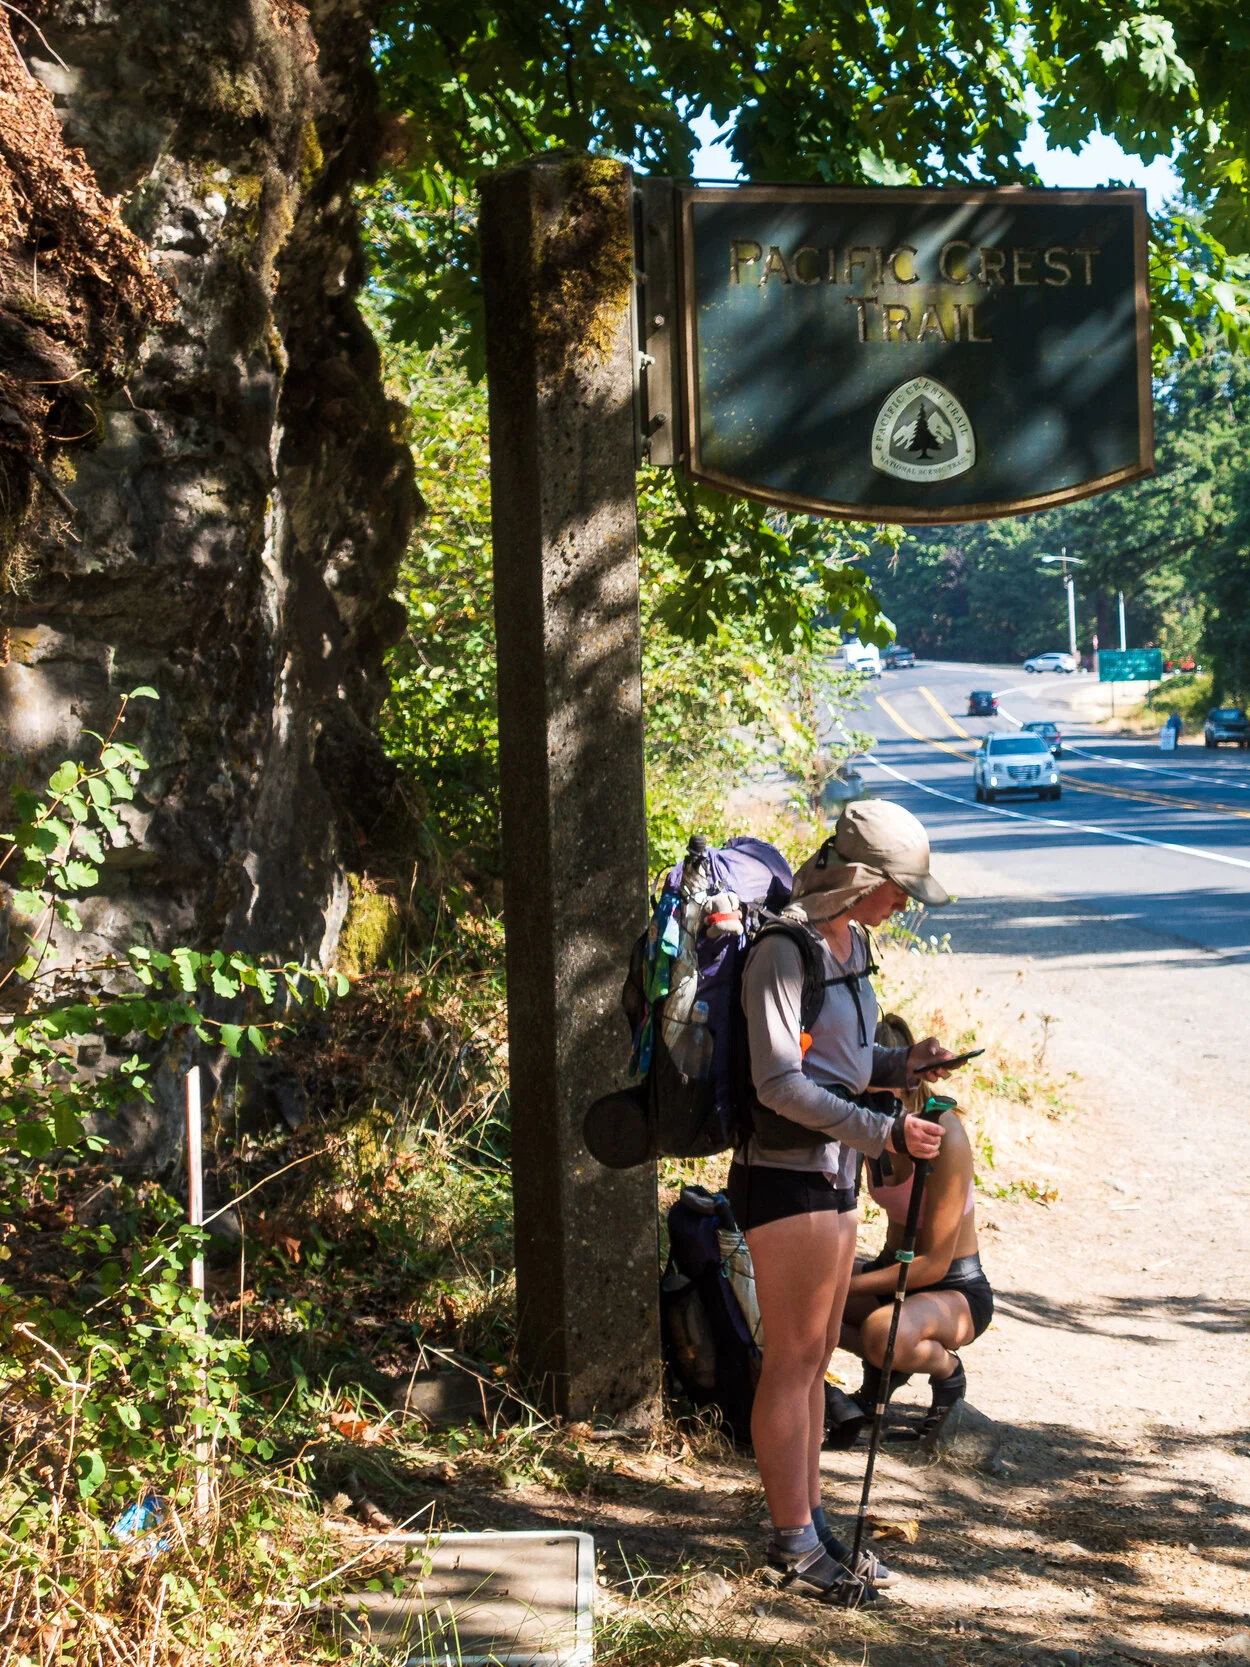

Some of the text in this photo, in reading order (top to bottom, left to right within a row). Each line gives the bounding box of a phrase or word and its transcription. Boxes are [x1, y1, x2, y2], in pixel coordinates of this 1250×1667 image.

[730, 239, 1101, 287] PACIFIC CREST
[847, 297, 993, 343] TRAIL
[876, 382, 968, 443] PACIFIC CREST TRAIL
[880, 455, 917, 474] NATIONAL
